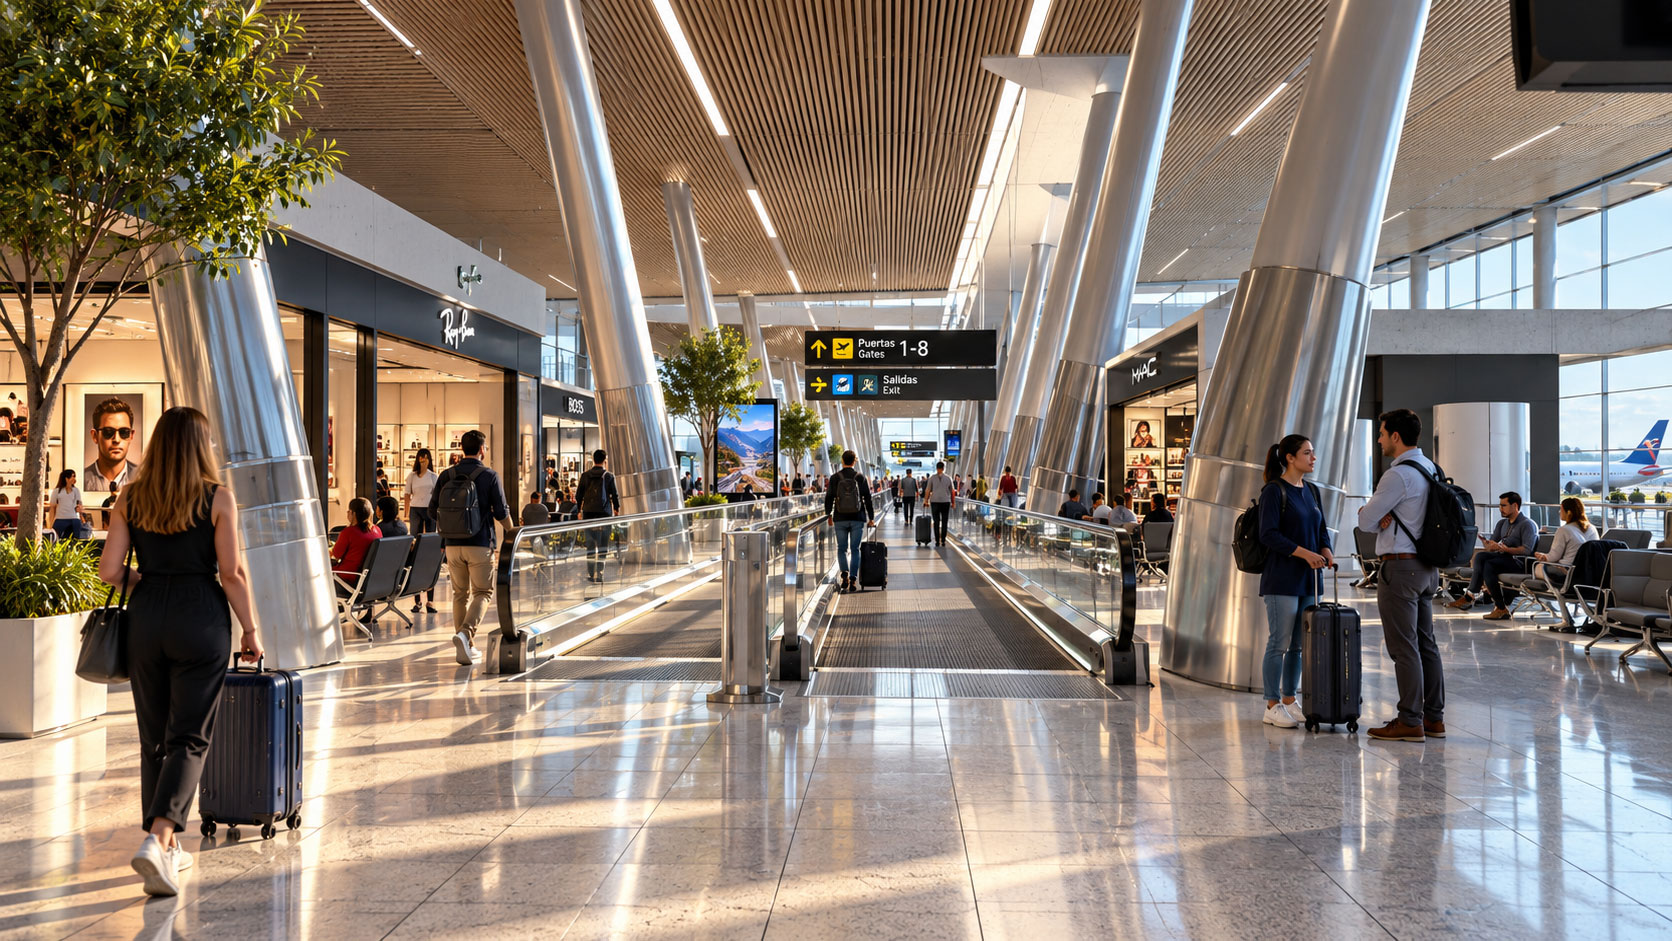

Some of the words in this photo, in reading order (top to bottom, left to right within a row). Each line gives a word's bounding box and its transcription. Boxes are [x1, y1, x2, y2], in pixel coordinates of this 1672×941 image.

[858, 338, 896, 348] Puertas
[899, 340, 929, 357] 1-8
[858, 350, 886, 359] Gates
[883, 374, 918, 384] Salidas
[882, 386, 901, 395] Exit
